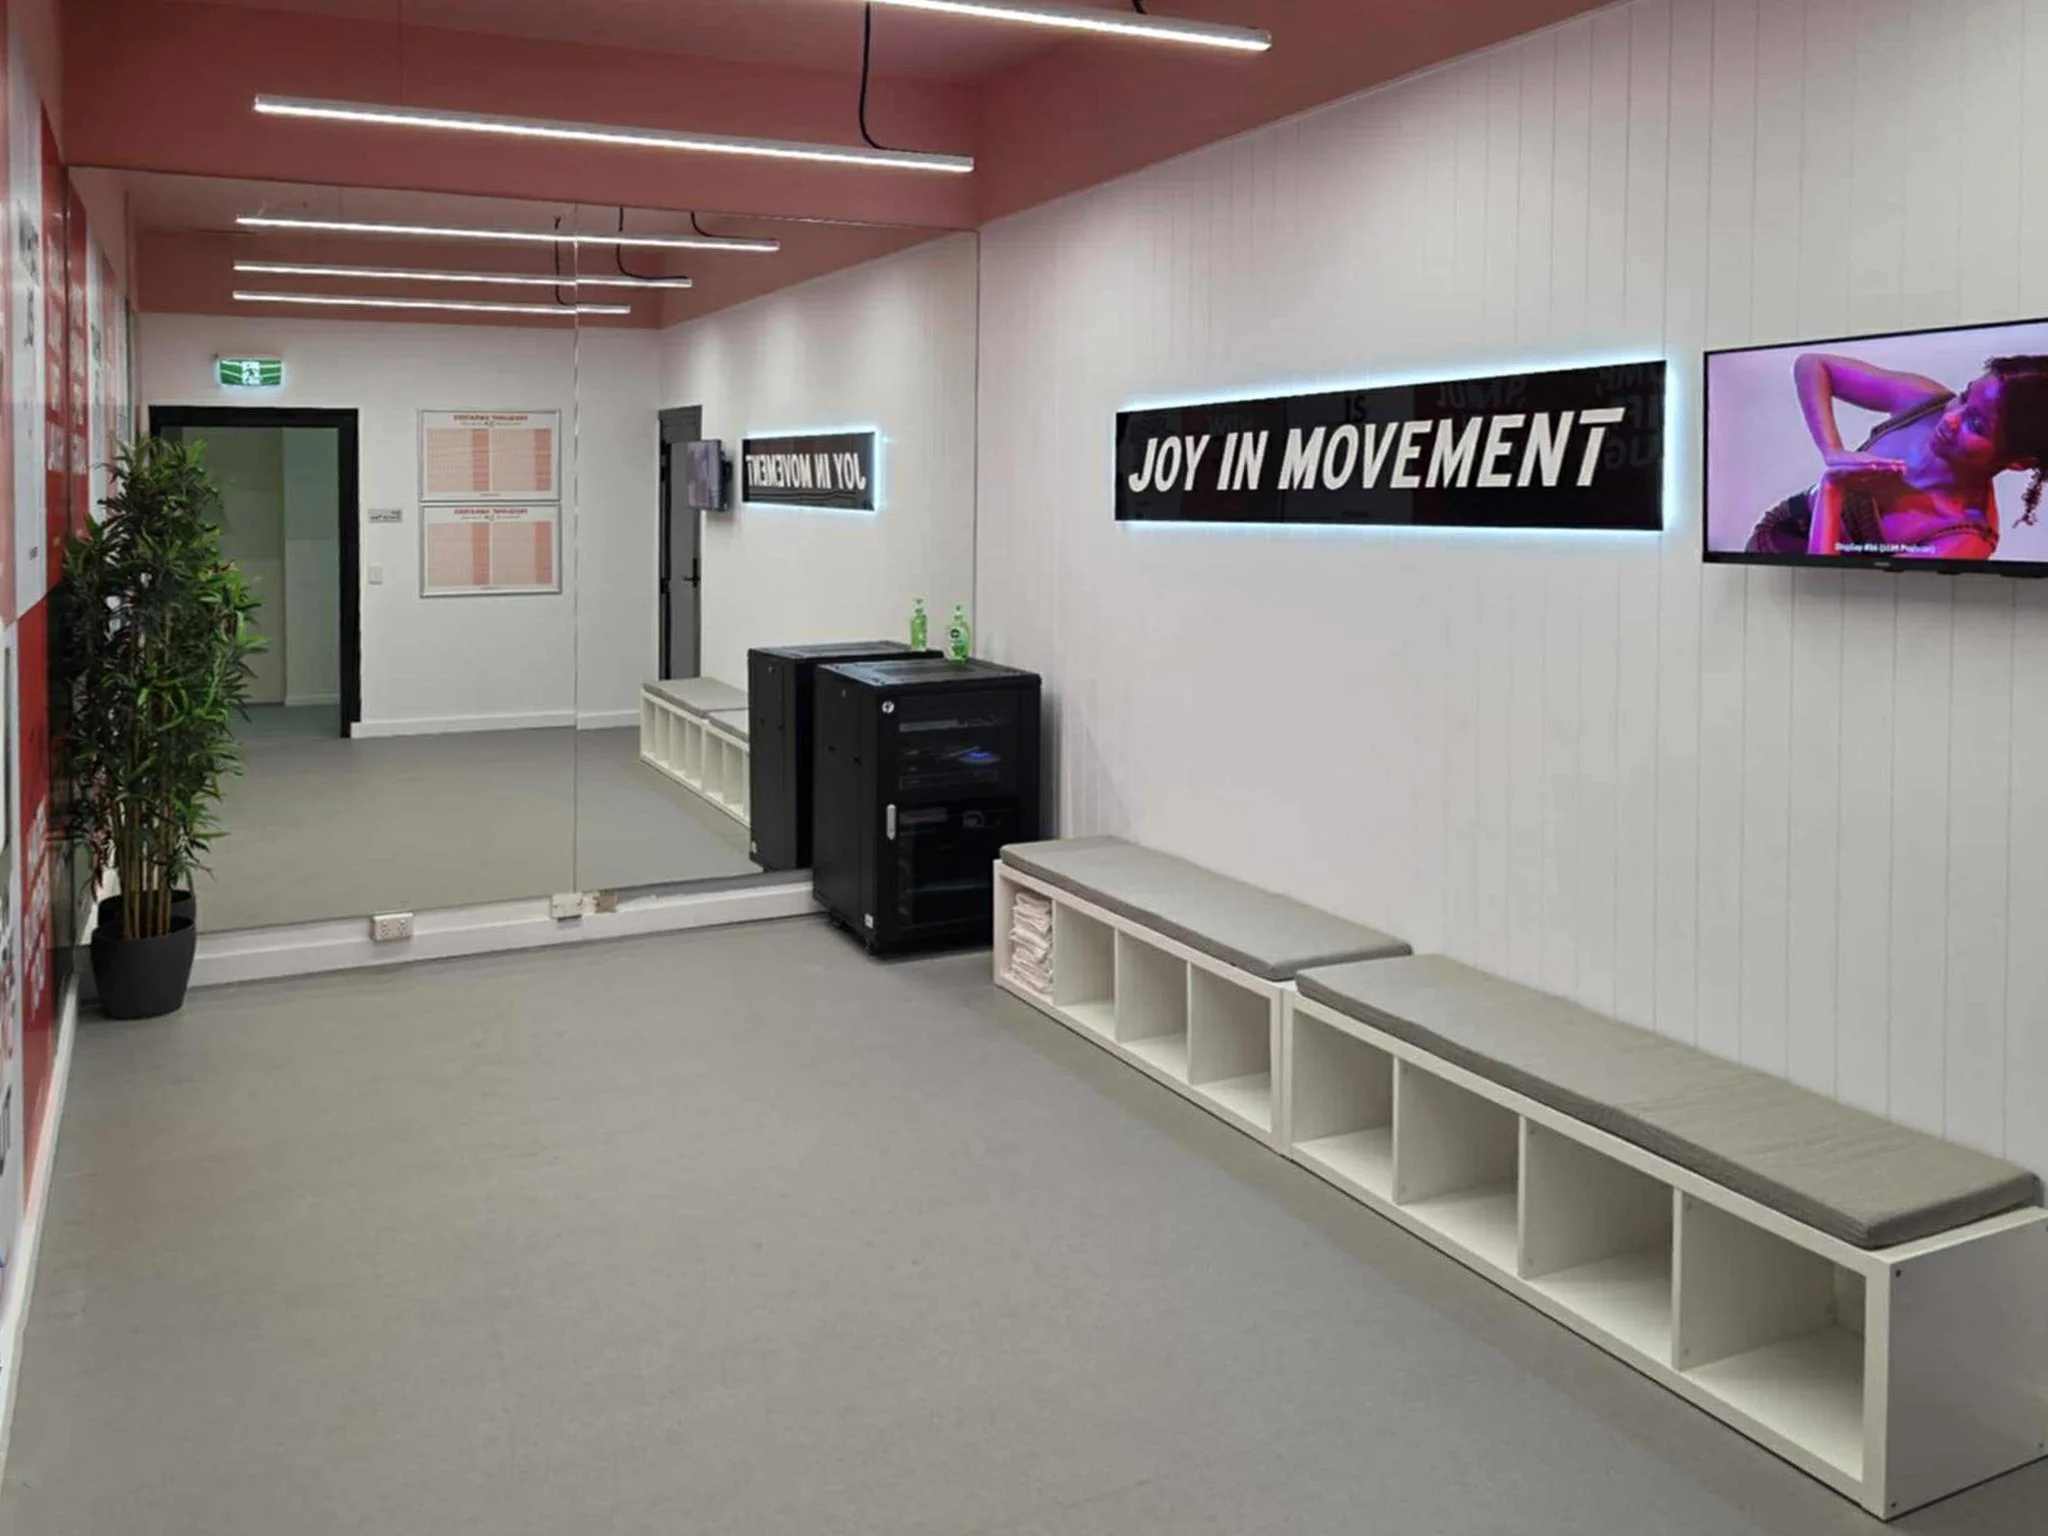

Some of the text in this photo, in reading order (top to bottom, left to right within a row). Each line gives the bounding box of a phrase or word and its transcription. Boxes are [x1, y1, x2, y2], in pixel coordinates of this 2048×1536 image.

[1128, 434, 1211, 492] JOY
[1216, 430, 1269, 490] IN
[1277, 407, 1625, 490] MOVEMENT
